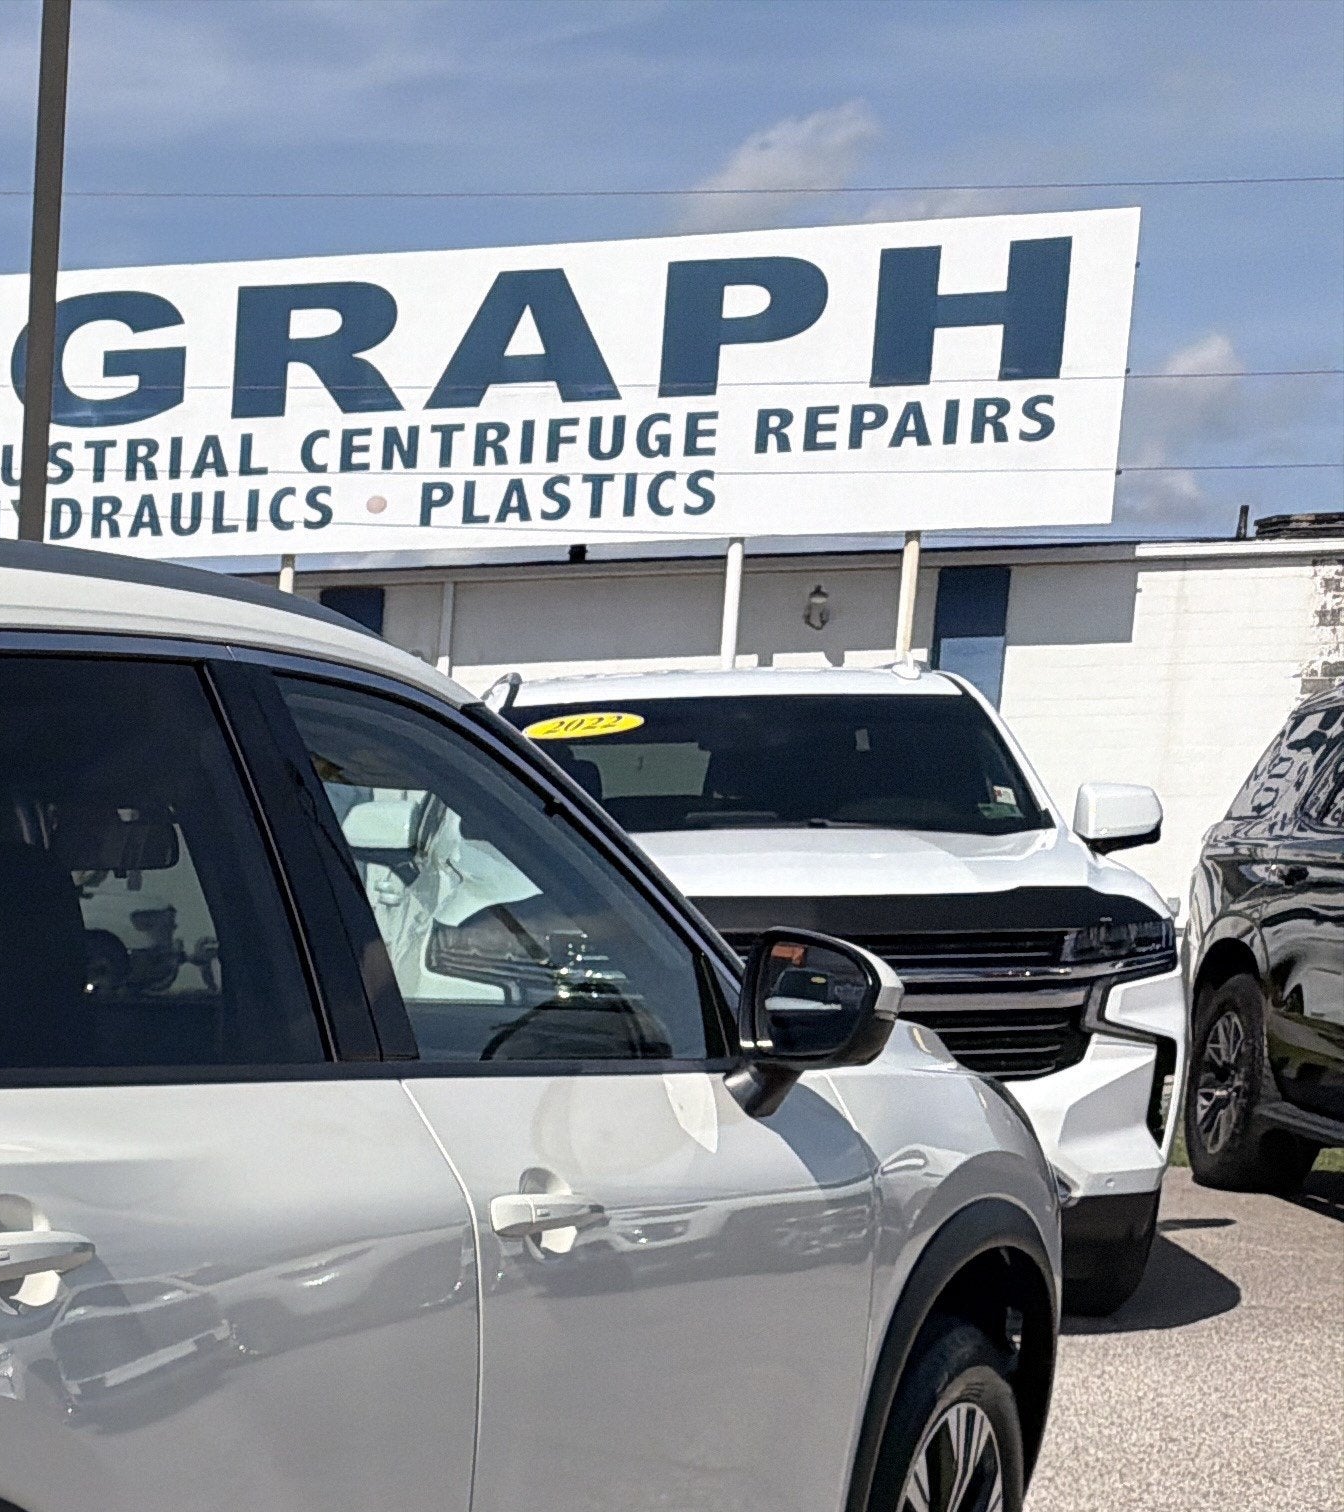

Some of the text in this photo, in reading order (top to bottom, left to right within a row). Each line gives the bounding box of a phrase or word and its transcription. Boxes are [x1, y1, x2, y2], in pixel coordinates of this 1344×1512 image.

[301, 410, 720, 474] CENTRIFUGE
[754, 394, 1056, 455] REPAIRS
[419, 469, 716, 526] PLASTICS
[543, 714, 623, 735] 2022
